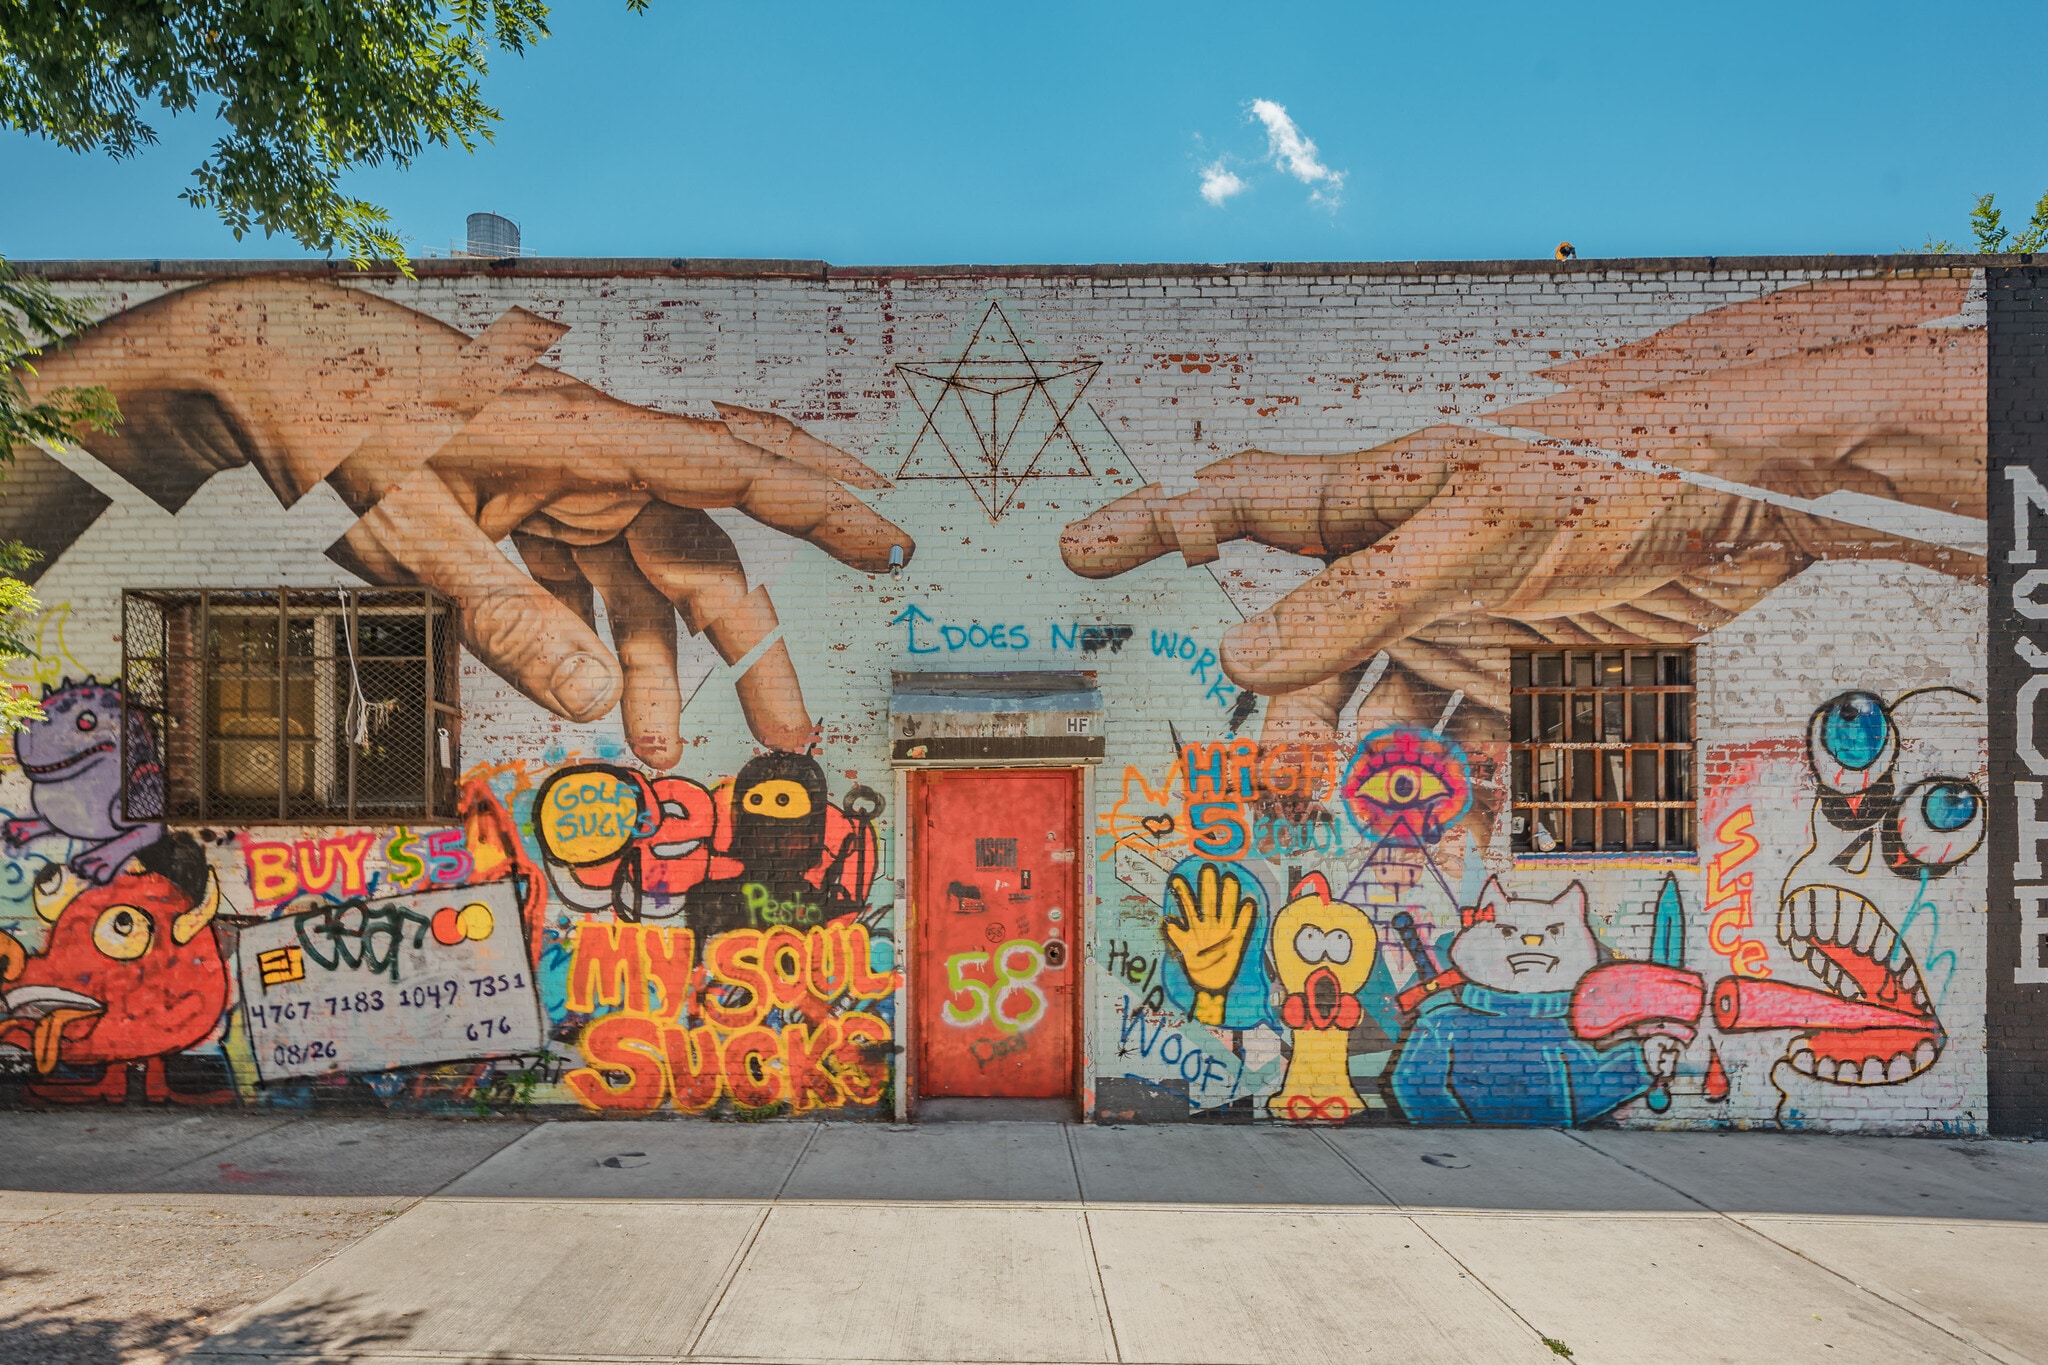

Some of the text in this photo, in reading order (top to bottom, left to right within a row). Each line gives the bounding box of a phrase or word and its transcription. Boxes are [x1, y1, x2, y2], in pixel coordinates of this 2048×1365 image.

[941, 624, 1030, 651] DOES
[1151, 629, 1235, 706] WORK
[1067, 718, 1088, 732] HF
[553, 782, 638, 811] GOLF
[556, 811, 656, 842] SUCKS
[1183, 799, 1250, 862] 5
[243, 826, 474, 908] BUY $5
[742, 882, 823, 925] Pesto
[251, 1001, 311, 1028] 4767
[325, 990, 385, 1015] 7183
[469, 973, 526, 998] 7351
[565, 921, 896, 1028] MY SOUL
[941, 938, 1048, 1033] 58
[1108, 939, 1164, 1017] Help
[273, 1040, 337, 1066] 08/26
[466, 1016, 511, 1041] 676
[564, 1012, 893, 1117] SUCKS
